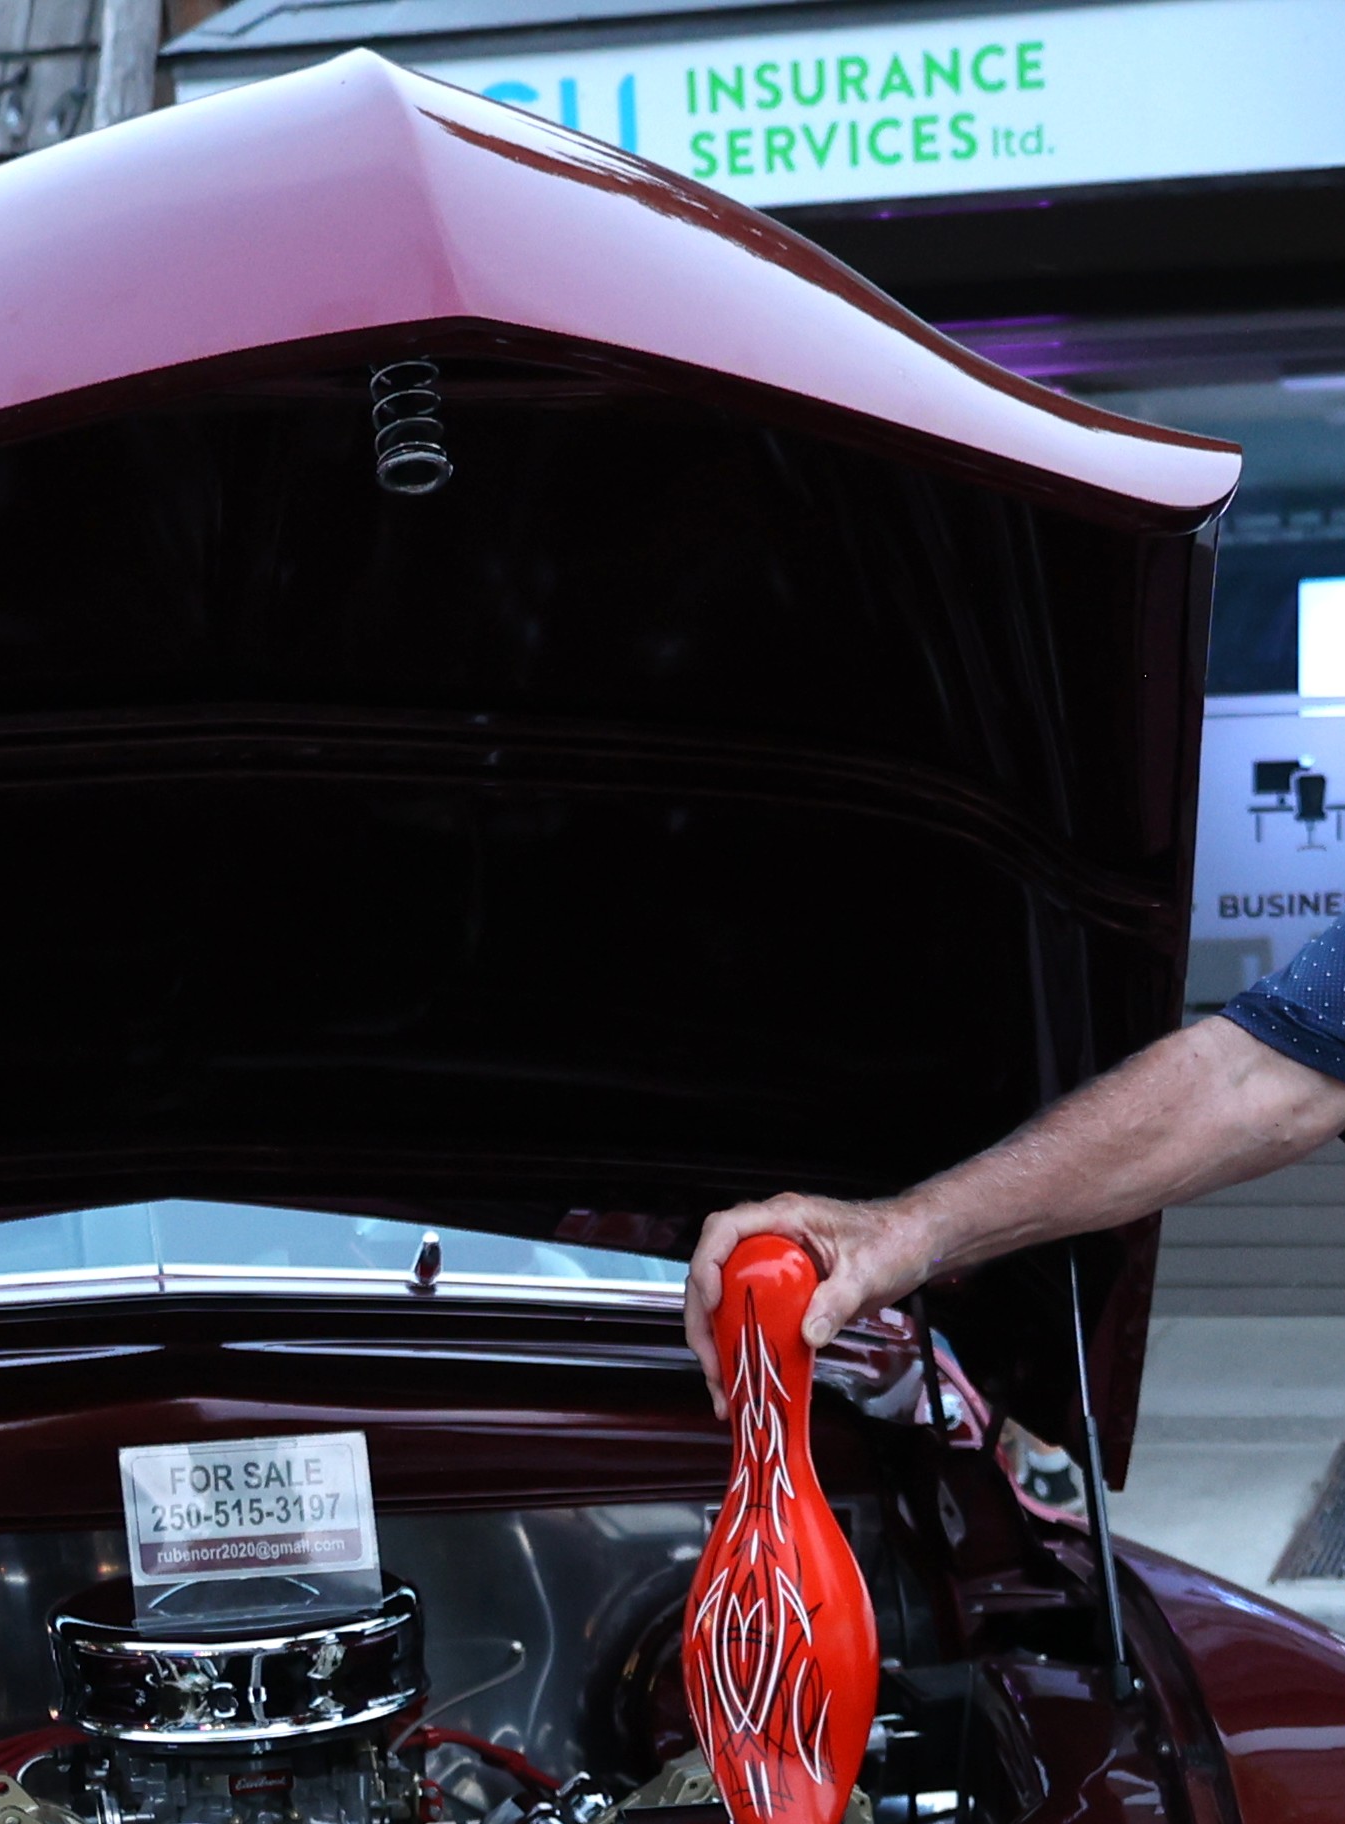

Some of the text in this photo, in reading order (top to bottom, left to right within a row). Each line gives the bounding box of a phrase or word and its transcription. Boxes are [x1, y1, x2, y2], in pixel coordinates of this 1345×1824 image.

[686, 42, 1046, 115] INSURANCE
[690, 112, 979, 179] SERVICES
[991, 124, 1056, 159] ltd.
[170, 1458, 324, 1495] FOR SALE
[151, 1492, 341, 1533] 250-515-3197
